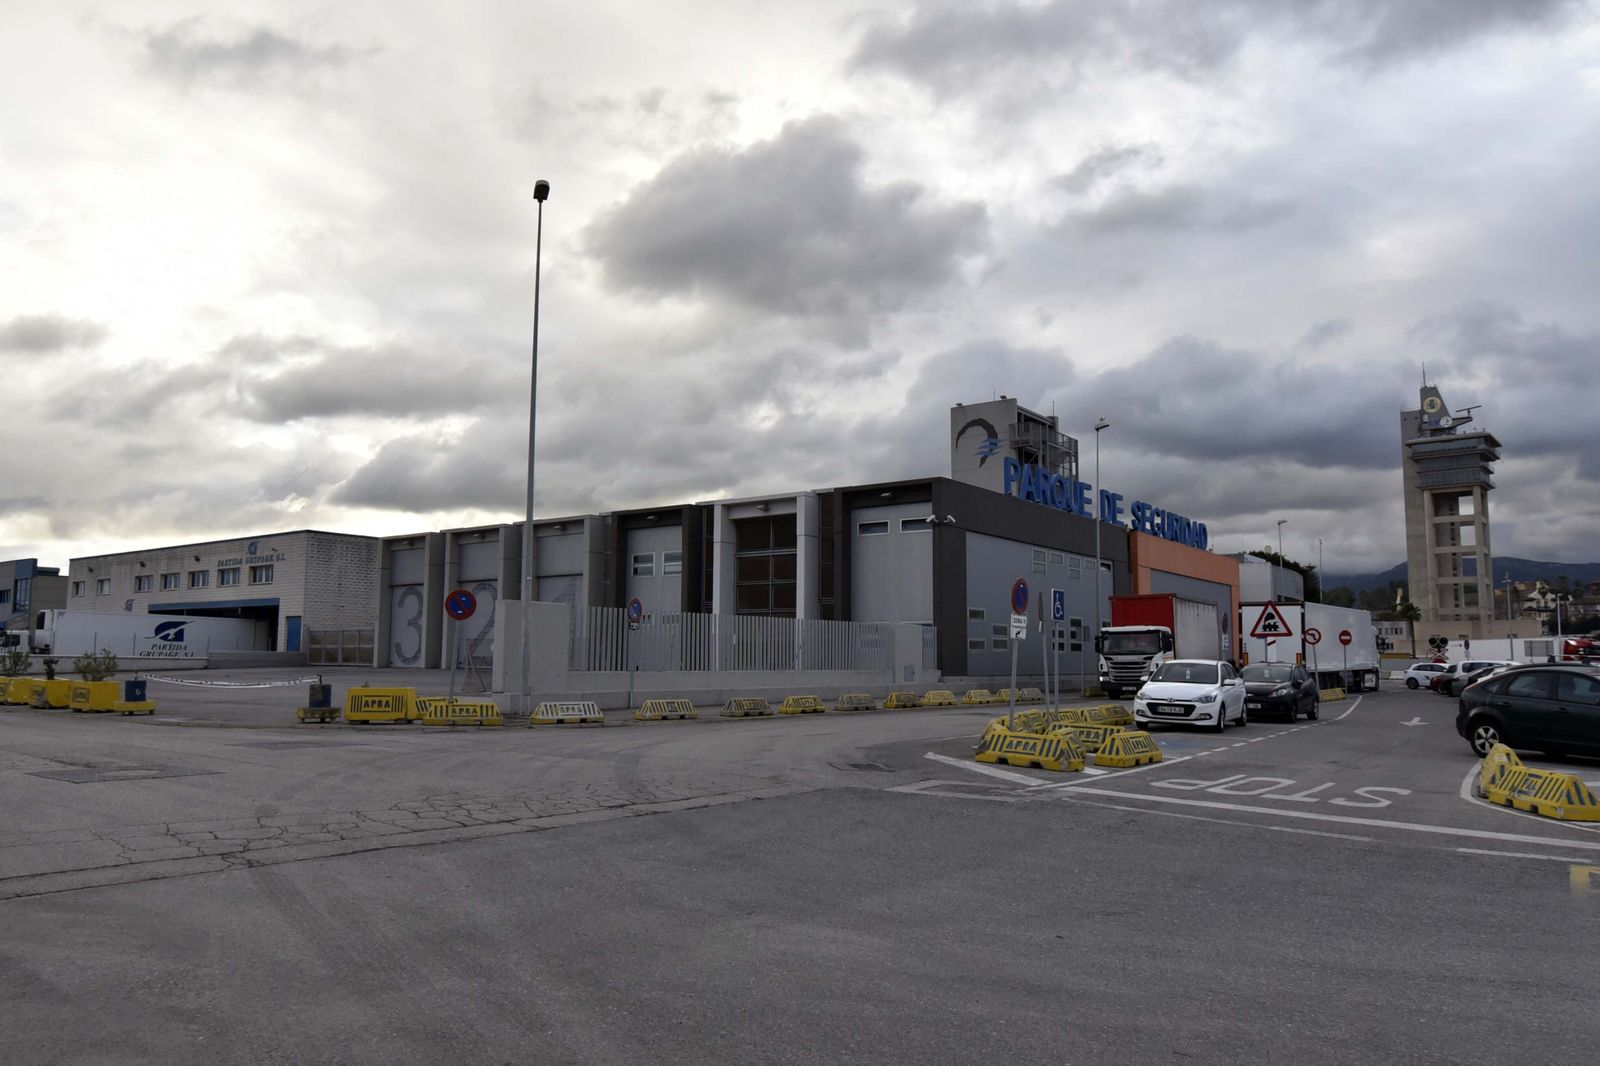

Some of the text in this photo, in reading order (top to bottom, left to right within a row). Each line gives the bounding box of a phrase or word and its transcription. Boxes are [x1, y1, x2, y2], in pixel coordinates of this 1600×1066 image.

[1003, 456, 1208, 550] PARQUE DE SEGURIDAD
[394, 586, 425, 665] 3
[1149, 774, 1412, 808] STOP
